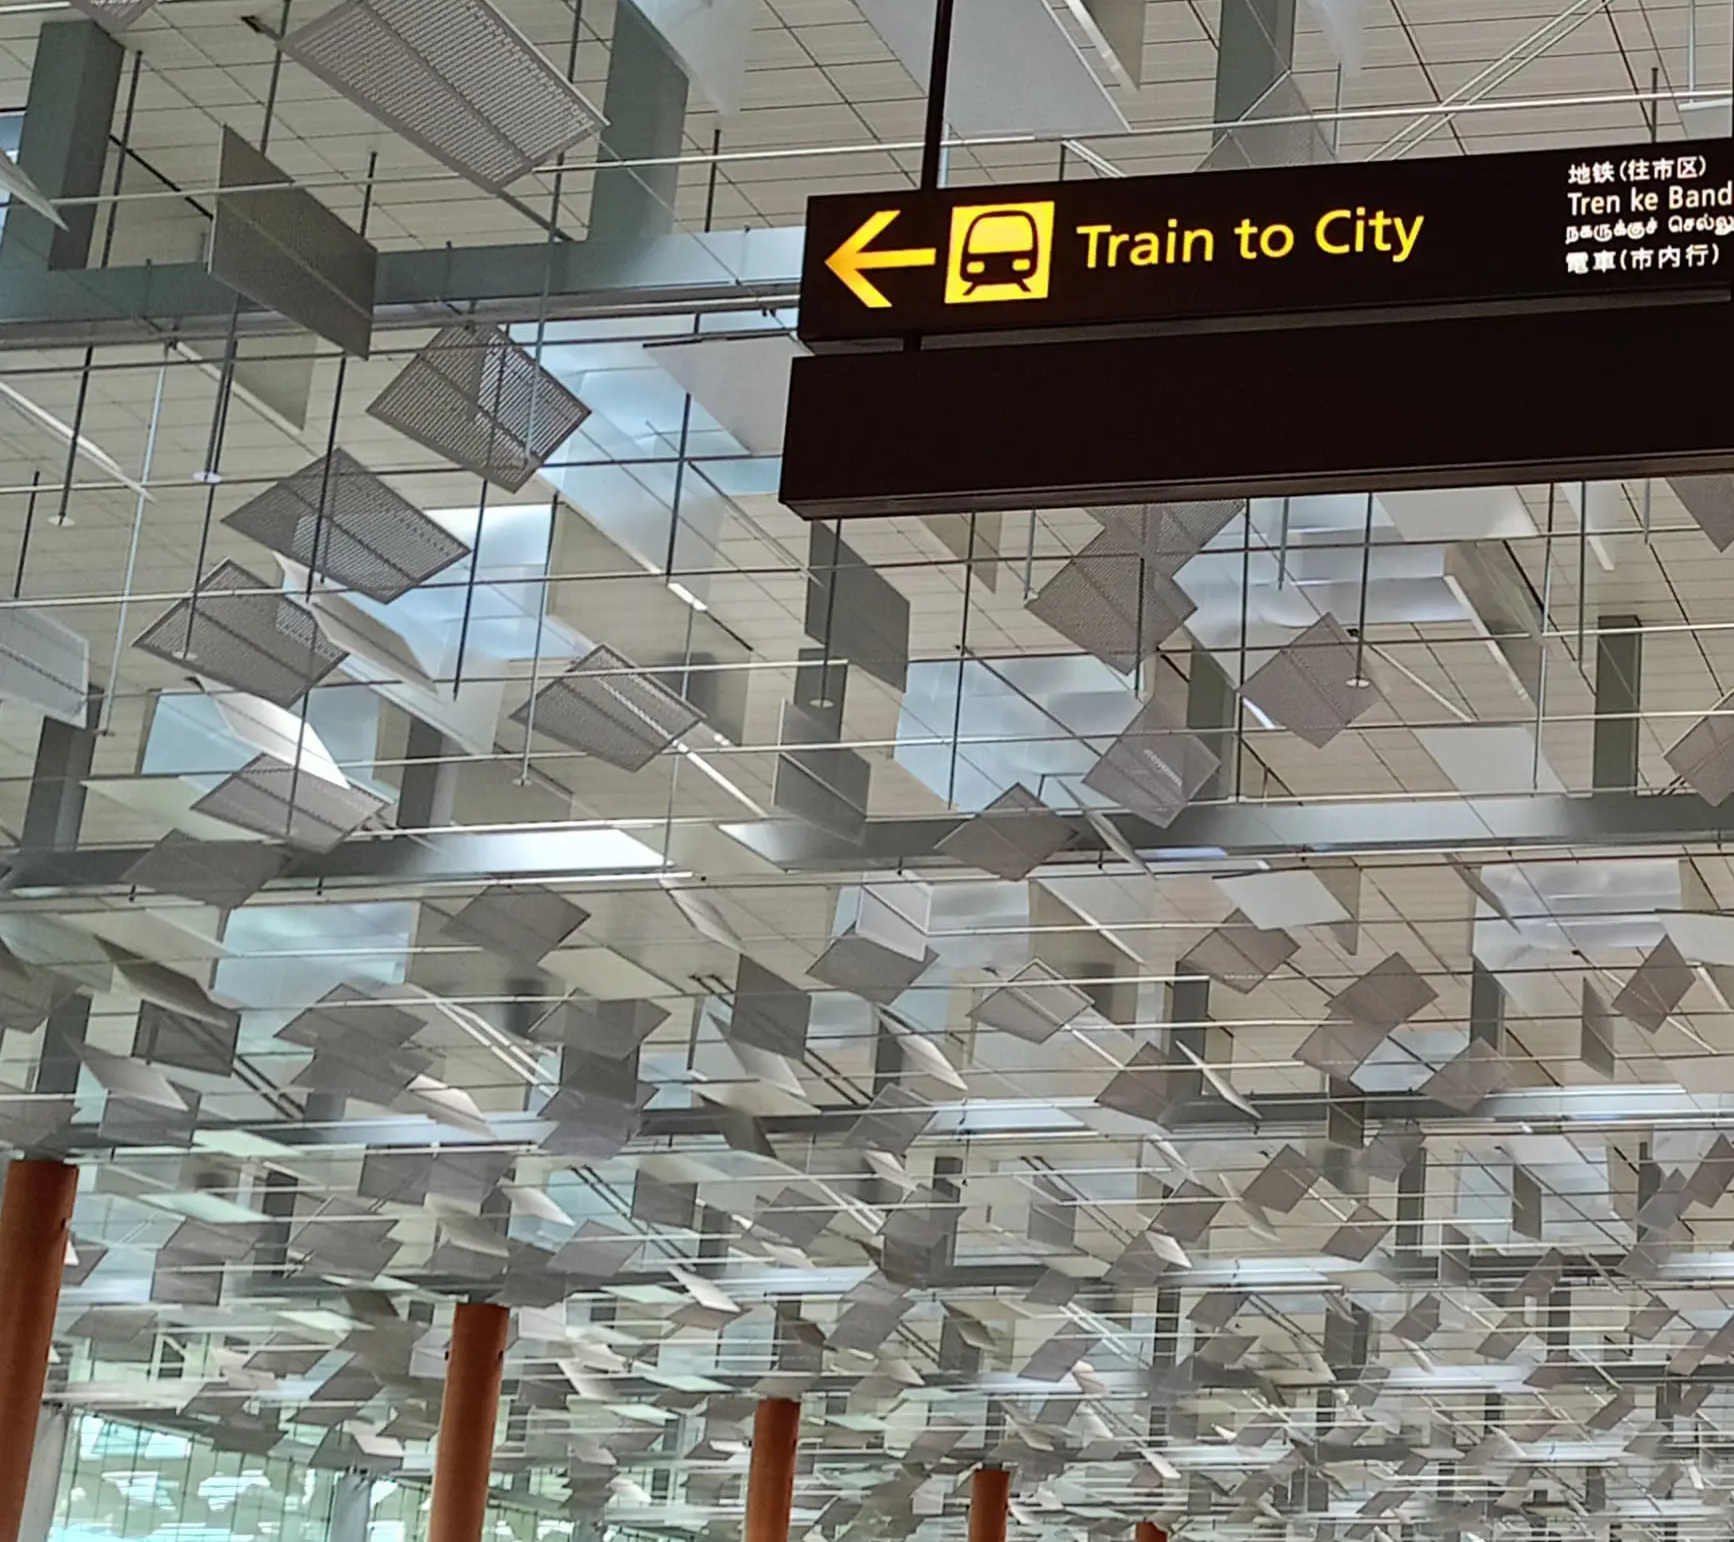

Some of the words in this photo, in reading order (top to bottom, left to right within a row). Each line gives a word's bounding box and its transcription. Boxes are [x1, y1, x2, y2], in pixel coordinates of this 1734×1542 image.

[1567, 191, 1621, 217] Tren
[1630, 186, 1659, 212] ke
[1077, 219, 1215, 269] Train
[1233, 218, 1295, 260] to
[1315, 206, 1425, 262] City
